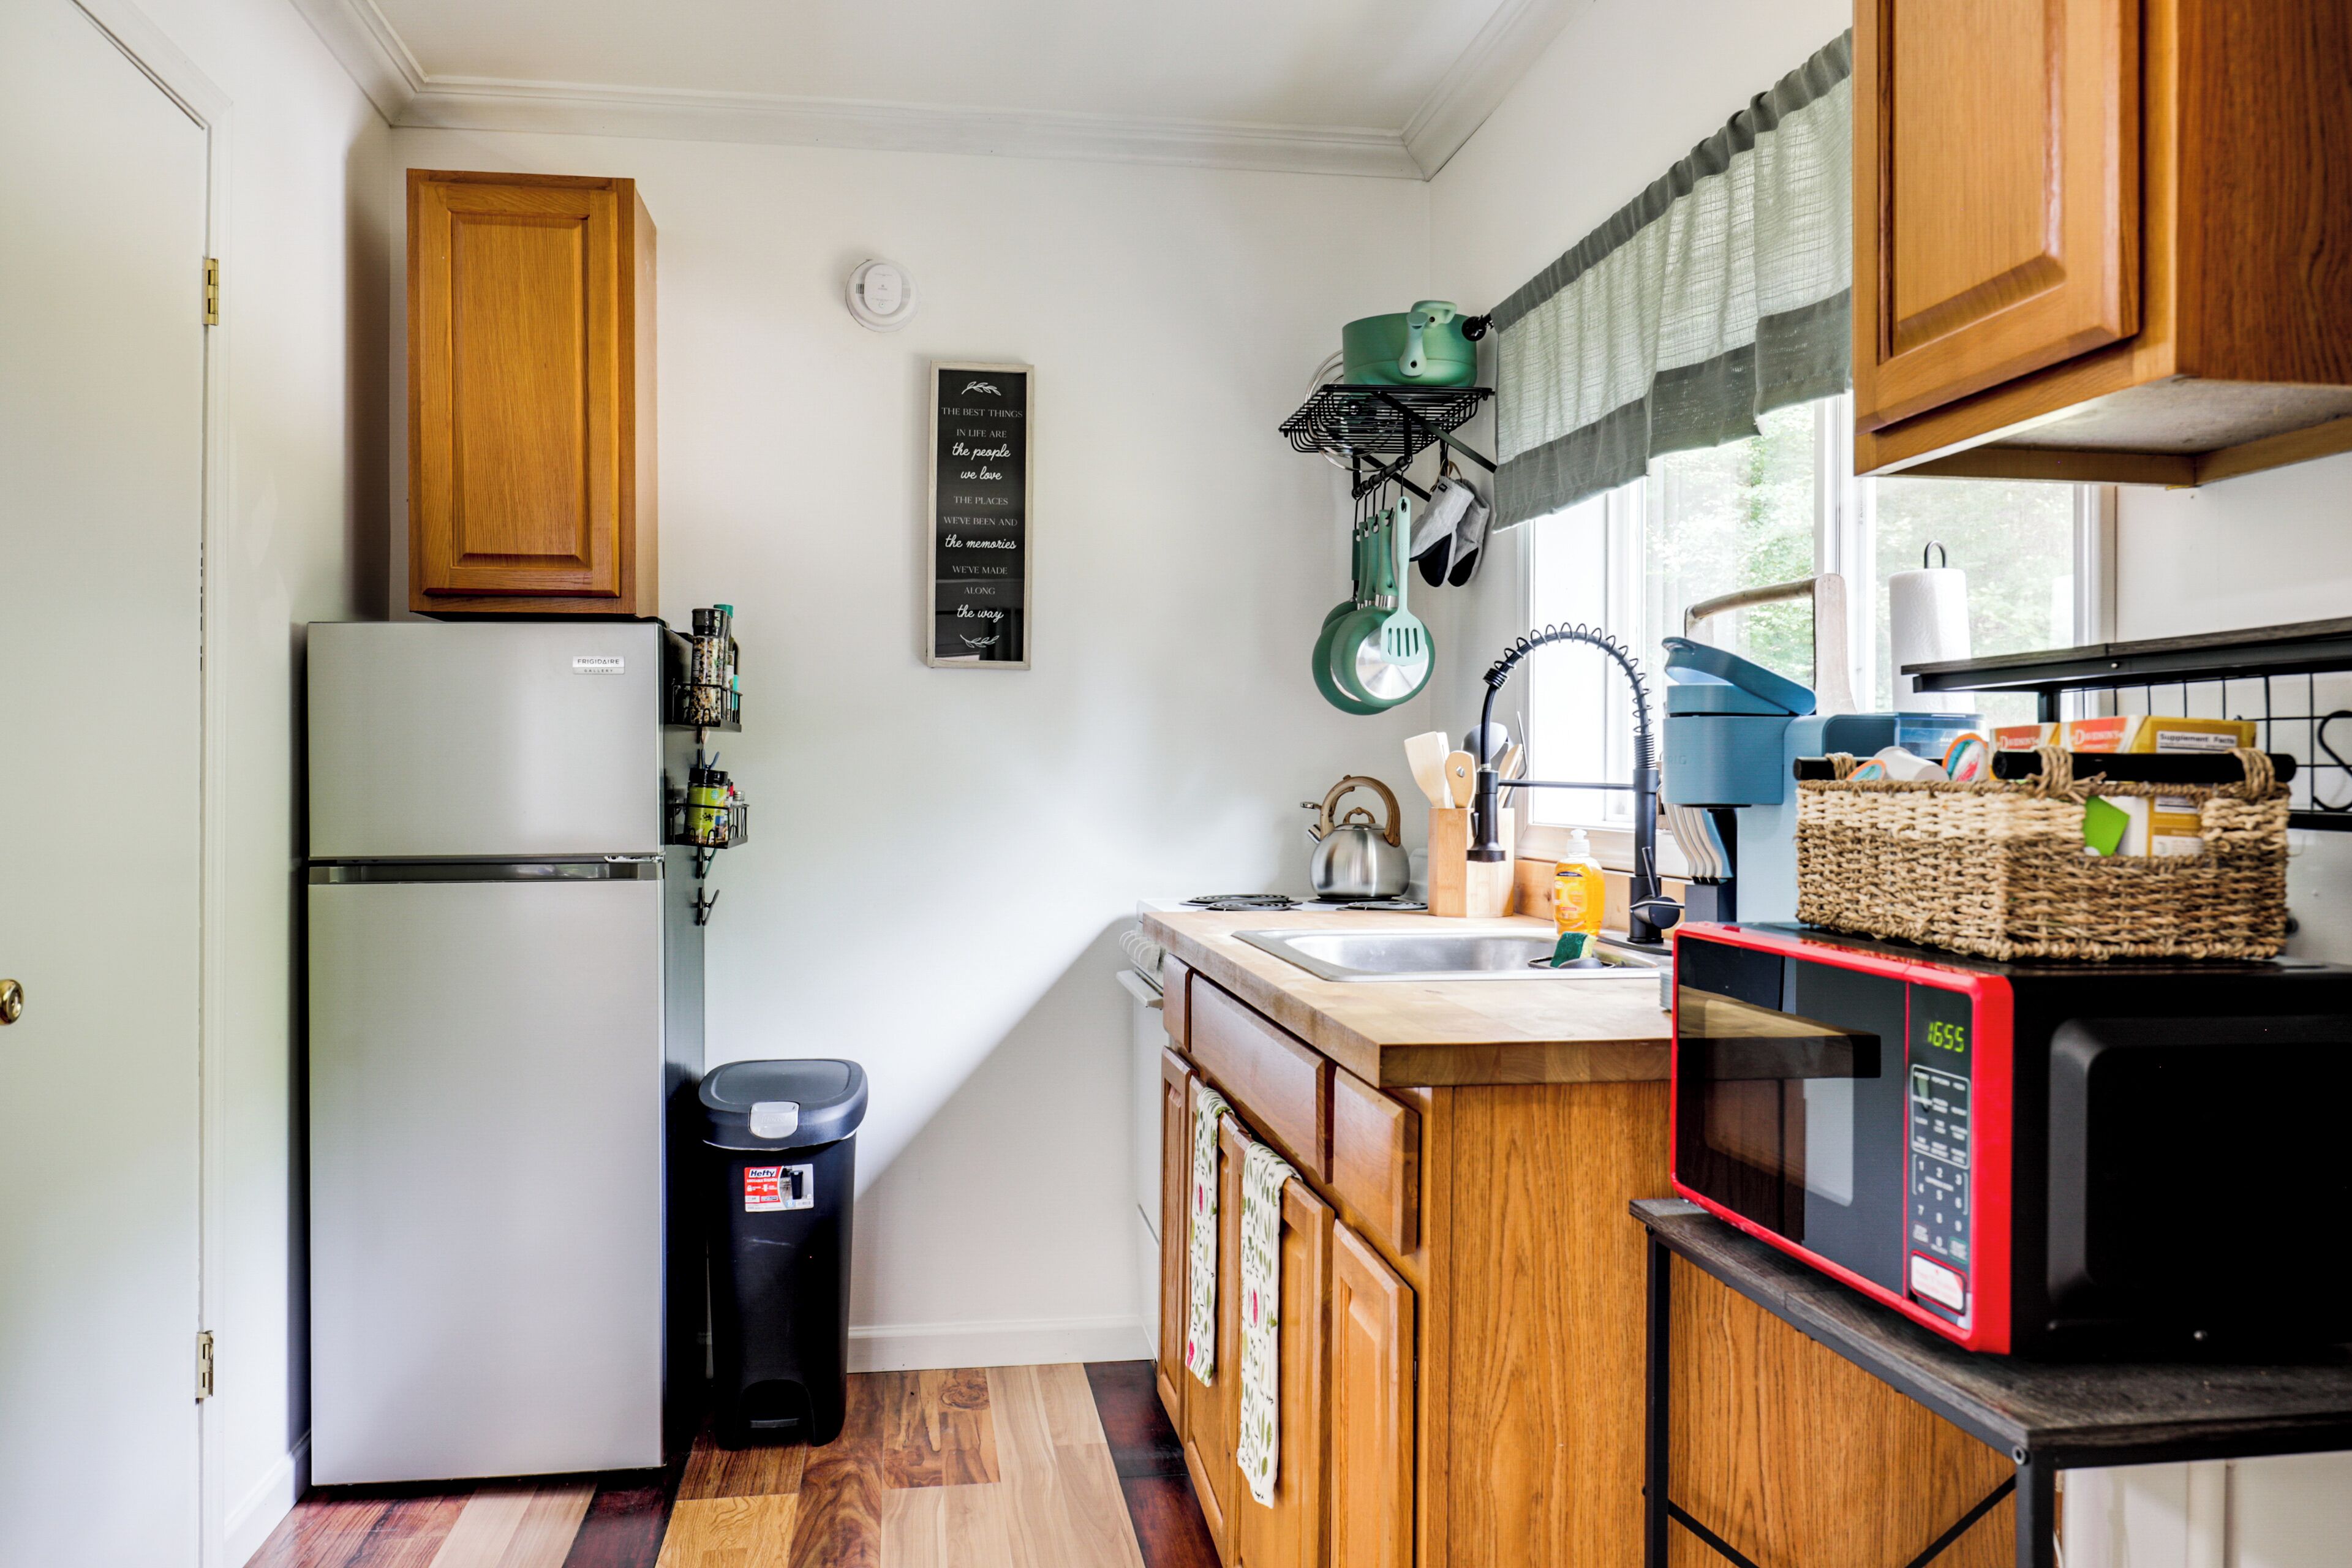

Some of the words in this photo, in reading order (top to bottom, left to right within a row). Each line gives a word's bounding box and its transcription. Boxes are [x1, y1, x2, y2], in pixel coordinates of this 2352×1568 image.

[988, 409, 1023, 418] THINGS
[952, 442, 970, 456] the
[971, 443, 1011, 461] people
[960, 471, 977, 480] we
[979, 466, 1002, 480] love
[945, 534, 963, 548] the
[966, 539, 1017, 549] memories
[957, 605, 974, 618] the
[978, 611, 1004, 623] way
[2160, 734, 2209, 744] Supplement
